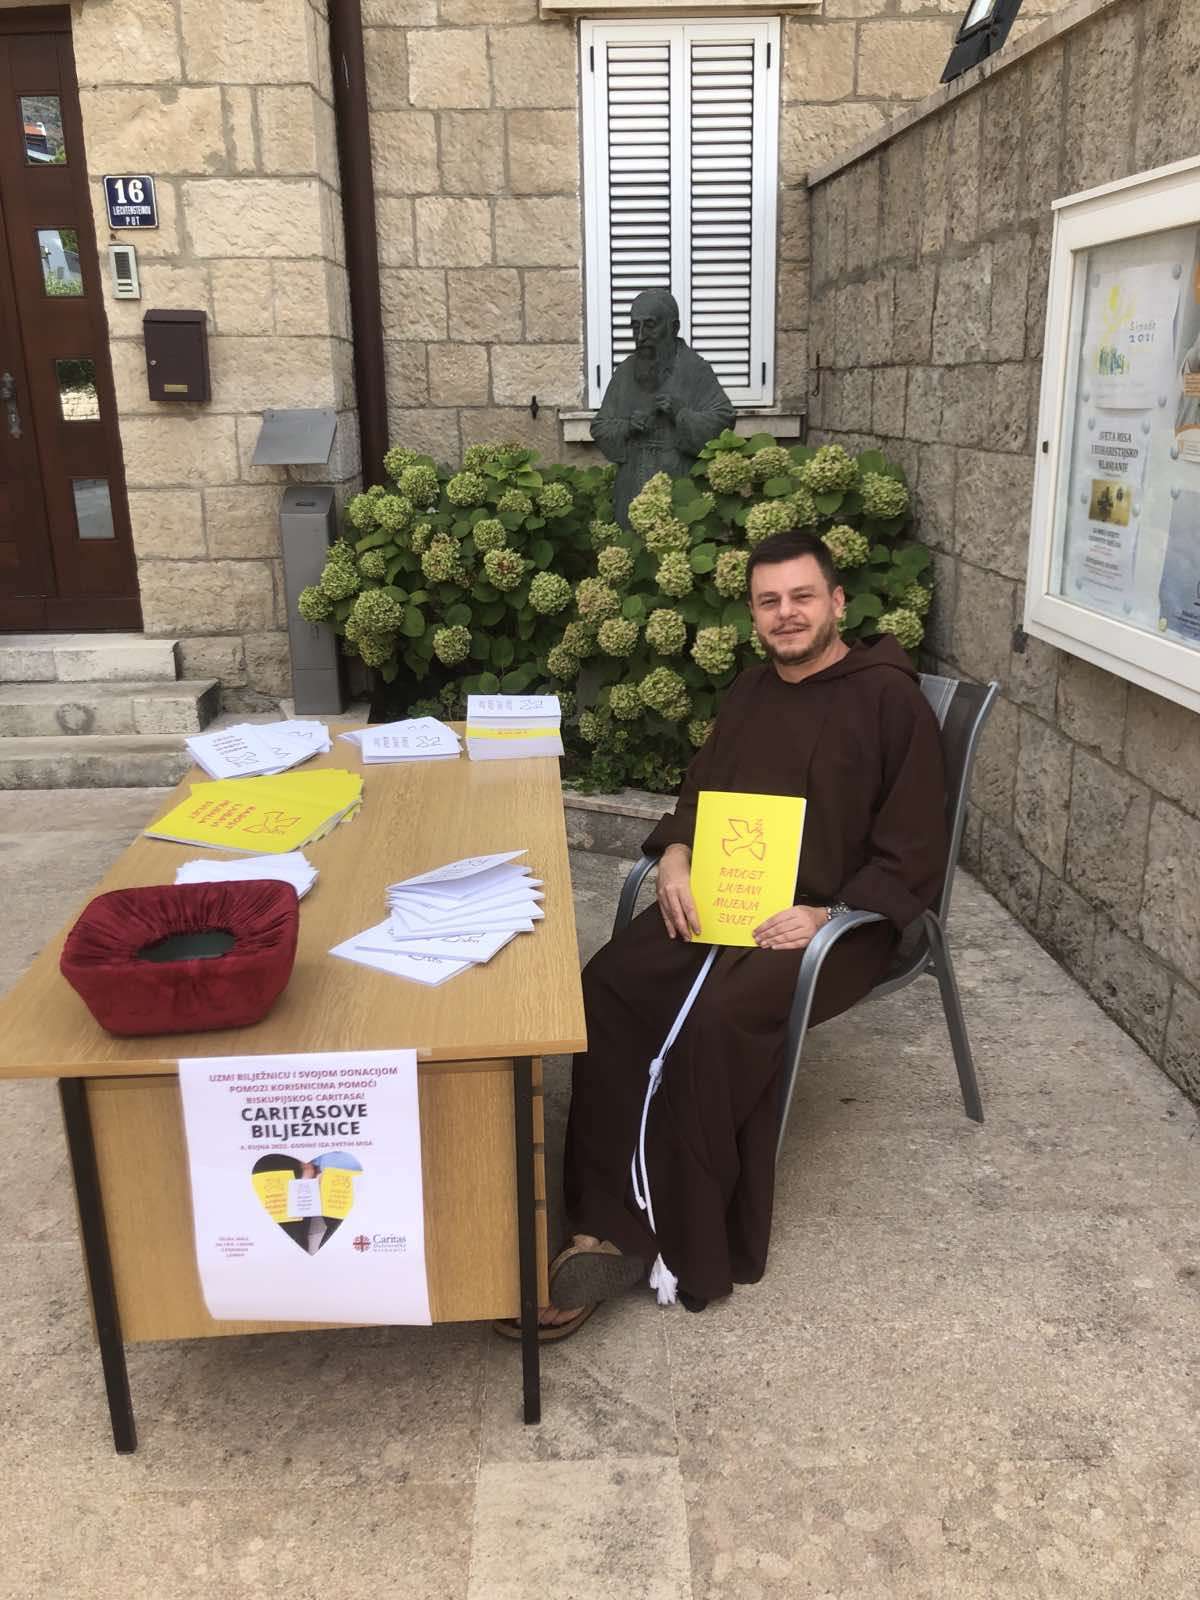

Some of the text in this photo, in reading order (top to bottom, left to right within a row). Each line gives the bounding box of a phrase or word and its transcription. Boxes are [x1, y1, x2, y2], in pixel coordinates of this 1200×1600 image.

[115, 179, 144, 203] 16
[125, 216, 140, 226] PUT
[719, 867, 765, 880] RADOST
[209, 1074, 235, 1082] UZMI
[237, 1071, 291, 1082] BILJEŽNICU
[298, 1070, 338, 1080] SVOJOM
[340, 1067, 398, 1078] DONACIJOM
[230, 1085, 269, 1093] POMOZI
[271, 1082, 336, 1092] KORISNICIMA
[241, 1104, 368, 1121] CARITASOVE
[252, 1118, 361, 1141] BILJEŽNICE
